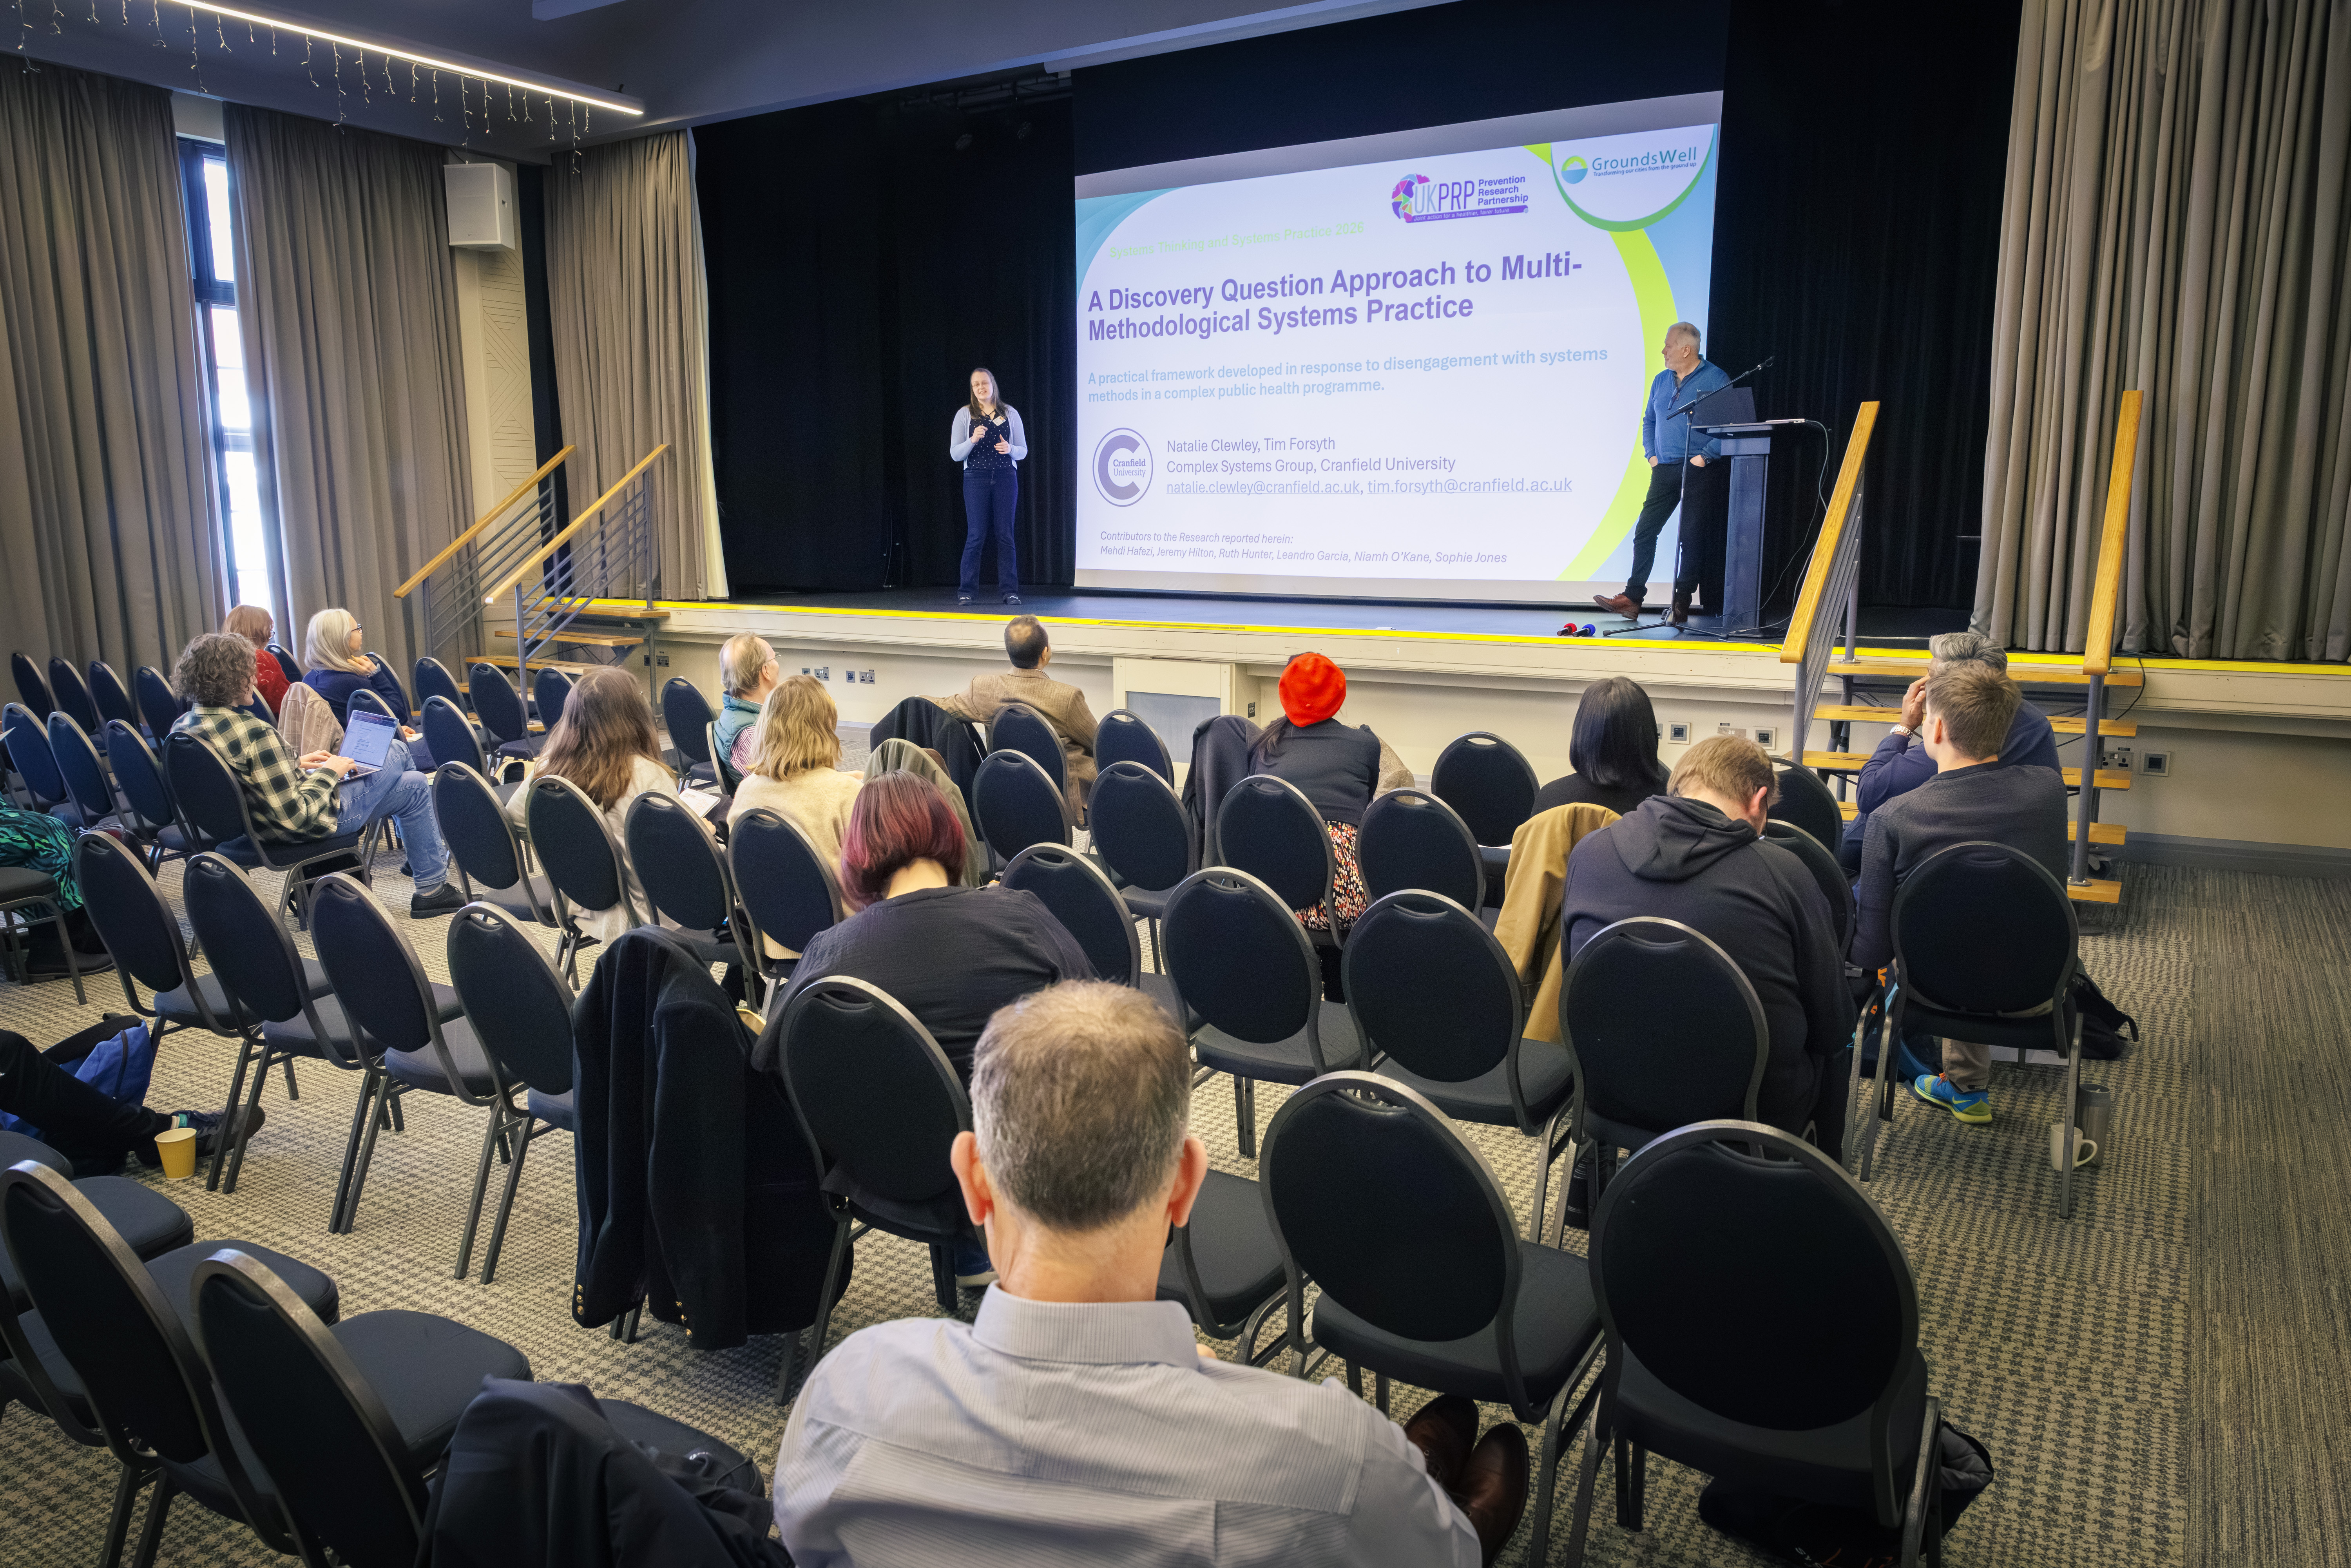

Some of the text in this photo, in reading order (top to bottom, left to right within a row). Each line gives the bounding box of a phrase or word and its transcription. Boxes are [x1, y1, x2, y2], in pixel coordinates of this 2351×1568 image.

[1592, 147, 1696, 170] GroundsWell
[1594, 167, 1624, 176] Transforming
[1670, 161, 1688, 170] ground
[1479, 176, 1525, 187] Prevention
[1415, 180, 1474, 214] UKPRP
[1478, 185, 1519, 196] Research
[1478, 194, 1528, 205] Partnership
[1110, 221, 1364, 260] Systems Thinking and Systems Practice 2026
[1088, 251, 1582, 312] A Discovery Question Approach to Multi-
[1089, 295, 1473, 340] Methodological Systems Practice
[1088, 348, 1608, 386] A practical framework developed in response to disengagement with systems
[1089, 379, 1384, 402] methods in a complex public health programme.
[1167, 437, 1335, 453] Natalie Clewley, Tim Forsyth
[1113, 458, 1146, 467] Cranfield
[1167, 456, 1456, 475] Complex Systems Group, Cranfield University
[1113, 469, 1146, 478] University
[1166, 478, 1572, 495] natalie.clewley@cranfield.ac.uk, tim.forsyth@cranfield.ac.uk
[1100, 531, 1293, 544] Contributors to the Research reported herein:
[1100, 546, 1125, 555] Mehdi
[1127, 546, 1154, 557] Hafezi,
[1157, 547, 1187, 559] Jeremy
[1188, 547, 1217, 559] Hilton,
[1219, 549, 1239, 558] Ruth
[1241, 549, 1274, 561] Hunter,
[1277, 549, 1315, 560] Leandro
[1317, 550, 1351, 562] Garcia,
[1354, 551, 1388, 562] Niamh
[1435, 552, 1473, 564] Sophie
[1474, 552, 1507, 563] Jones
